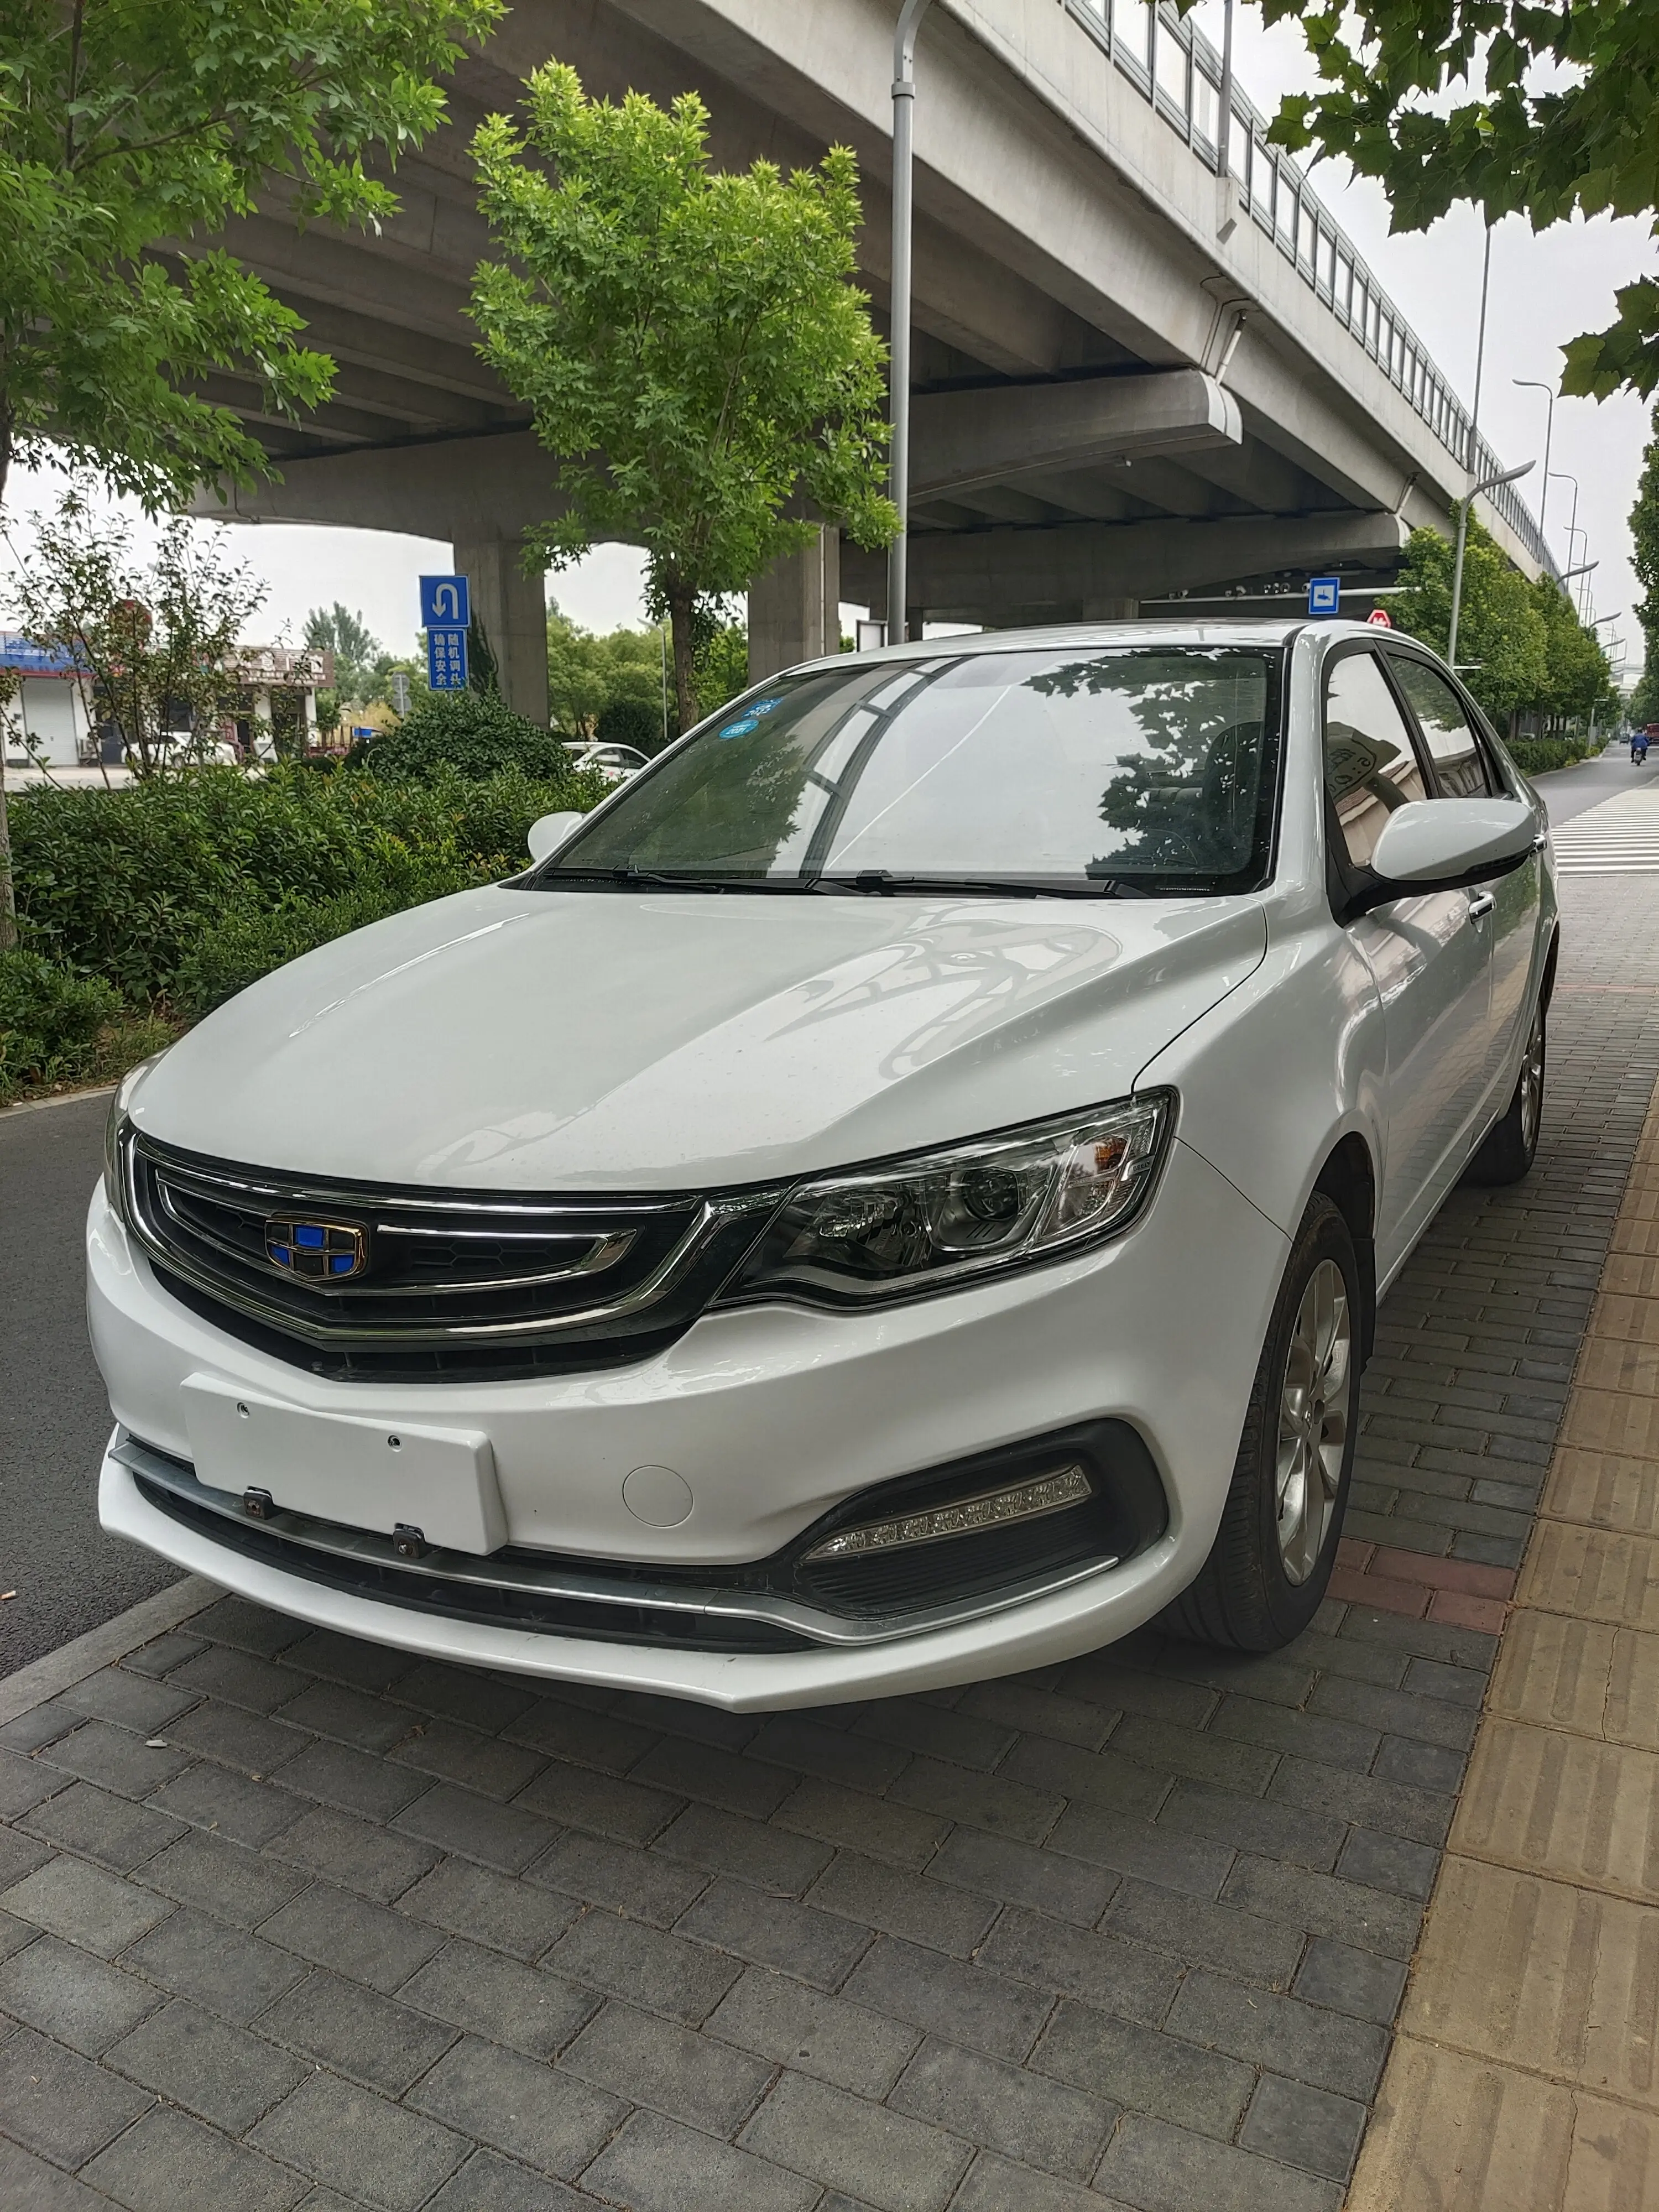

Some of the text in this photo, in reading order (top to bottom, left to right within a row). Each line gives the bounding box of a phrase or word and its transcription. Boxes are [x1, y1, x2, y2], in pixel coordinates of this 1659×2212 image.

[434, 633, 447, 685] 确保安全
[447, 633, 461, 685] 随机调头
[1133, 1161, 1151, 1171] GEELY
